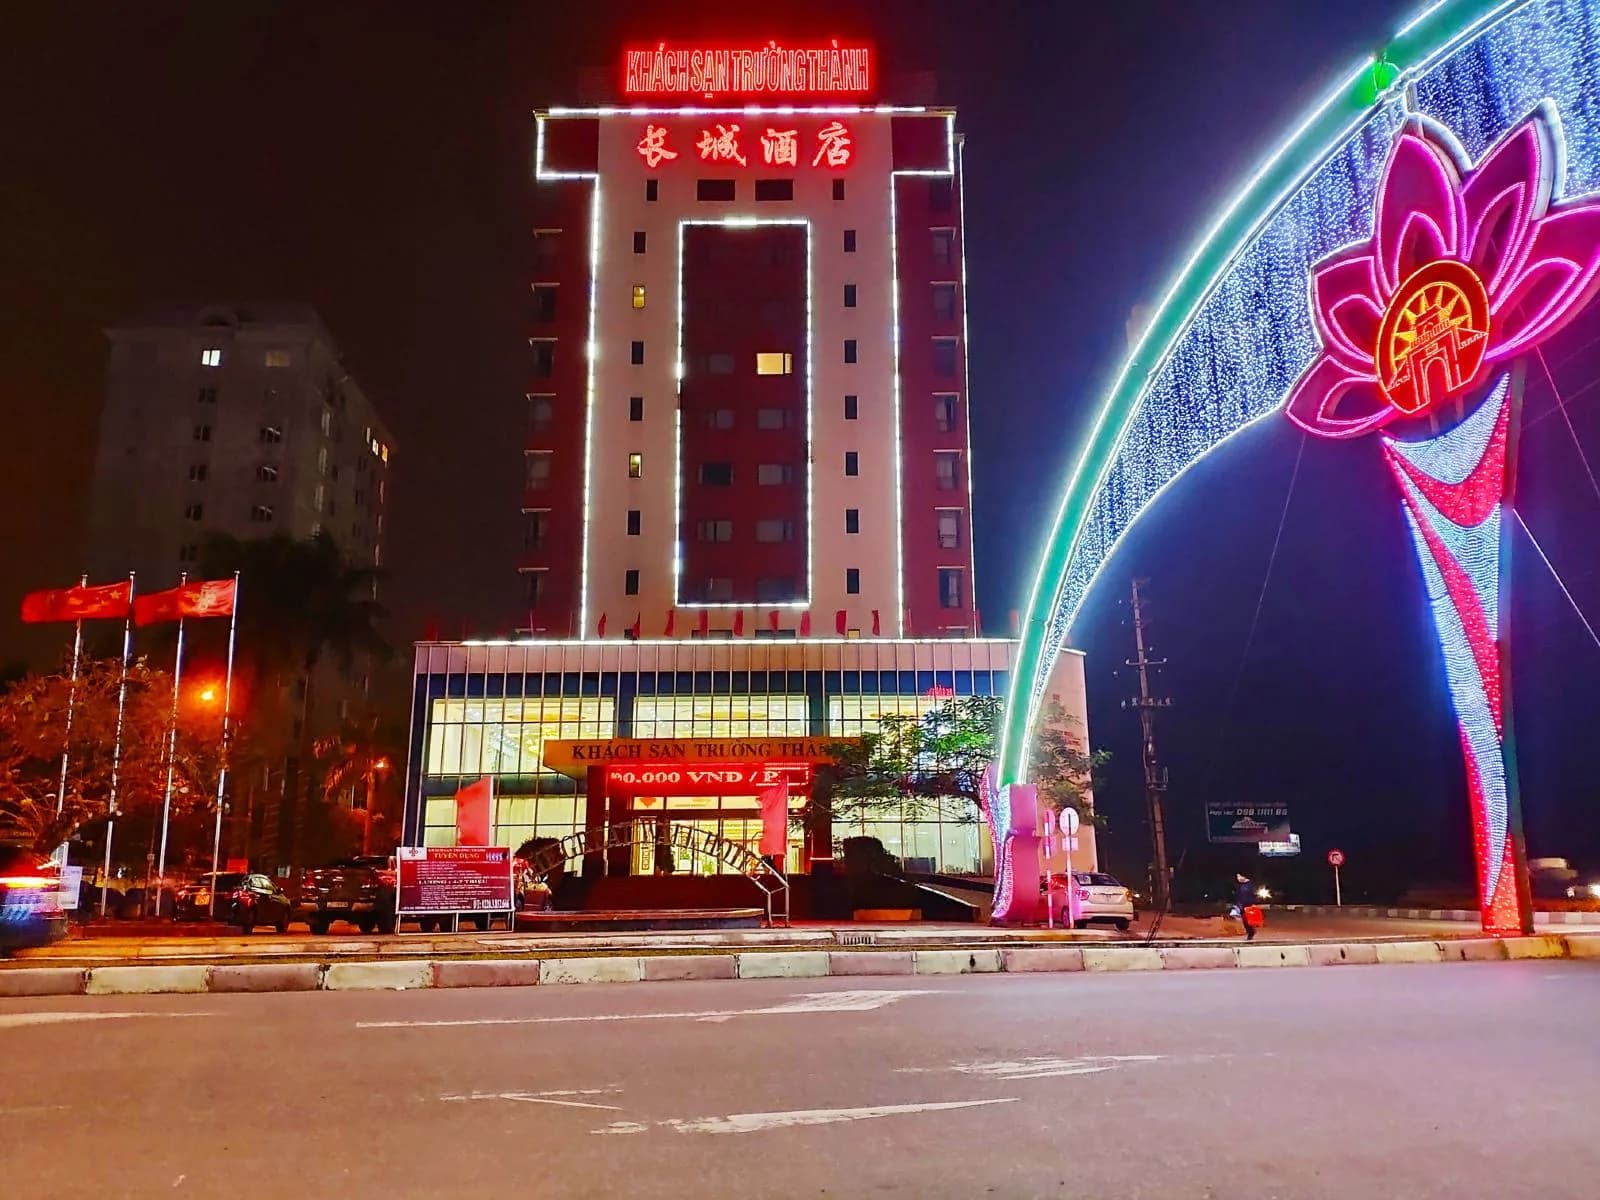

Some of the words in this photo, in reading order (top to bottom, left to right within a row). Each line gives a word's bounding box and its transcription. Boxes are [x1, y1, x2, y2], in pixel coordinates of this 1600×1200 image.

[626, 42, 689, 92] KHÁCH
[690, 50, 729, 98] SẠN
[731, 40, 806, 92] TRƯỜNG
[807, 39, 868, 91] THÀNH
[637, 121, 850, 168] 长城酒店
[572, 740, 641, 760] KHÁCH
